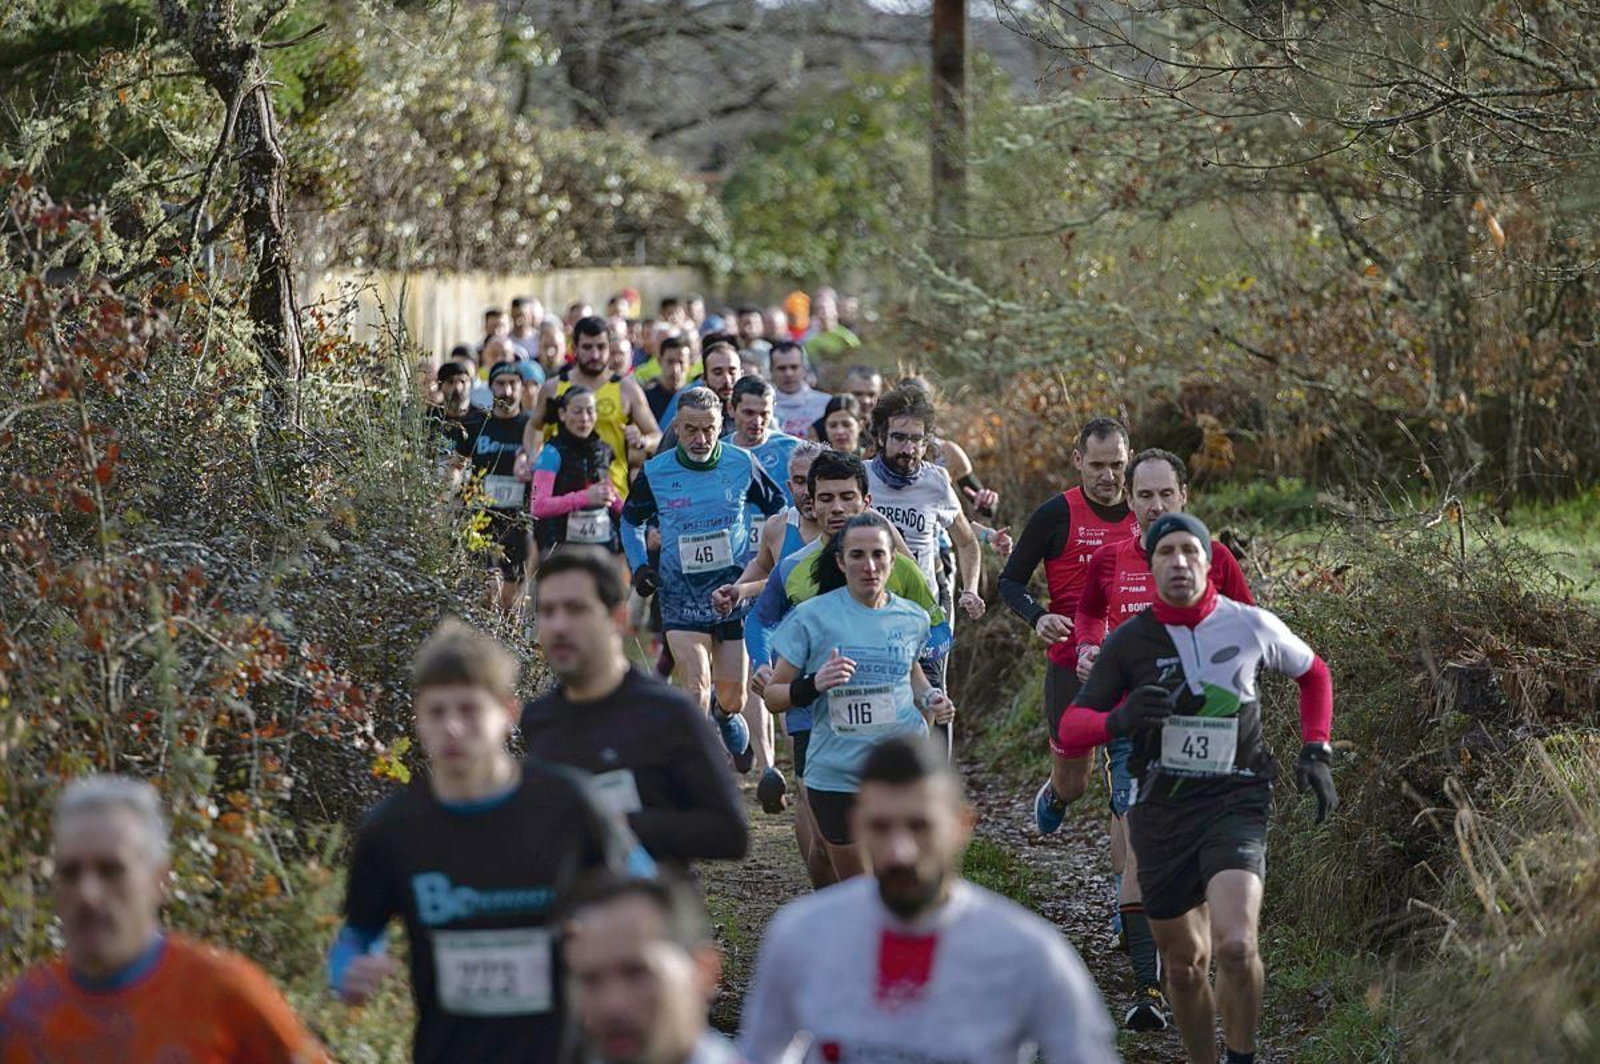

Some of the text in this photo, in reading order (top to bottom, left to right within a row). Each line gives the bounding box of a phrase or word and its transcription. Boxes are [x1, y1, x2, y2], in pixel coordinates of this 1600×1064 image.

[579, 522, 596, 536] 44
[695, 546, 714, 563] 46
[848, 703, 872, 725] 116
[1181, 736, 1209, 759] 43
